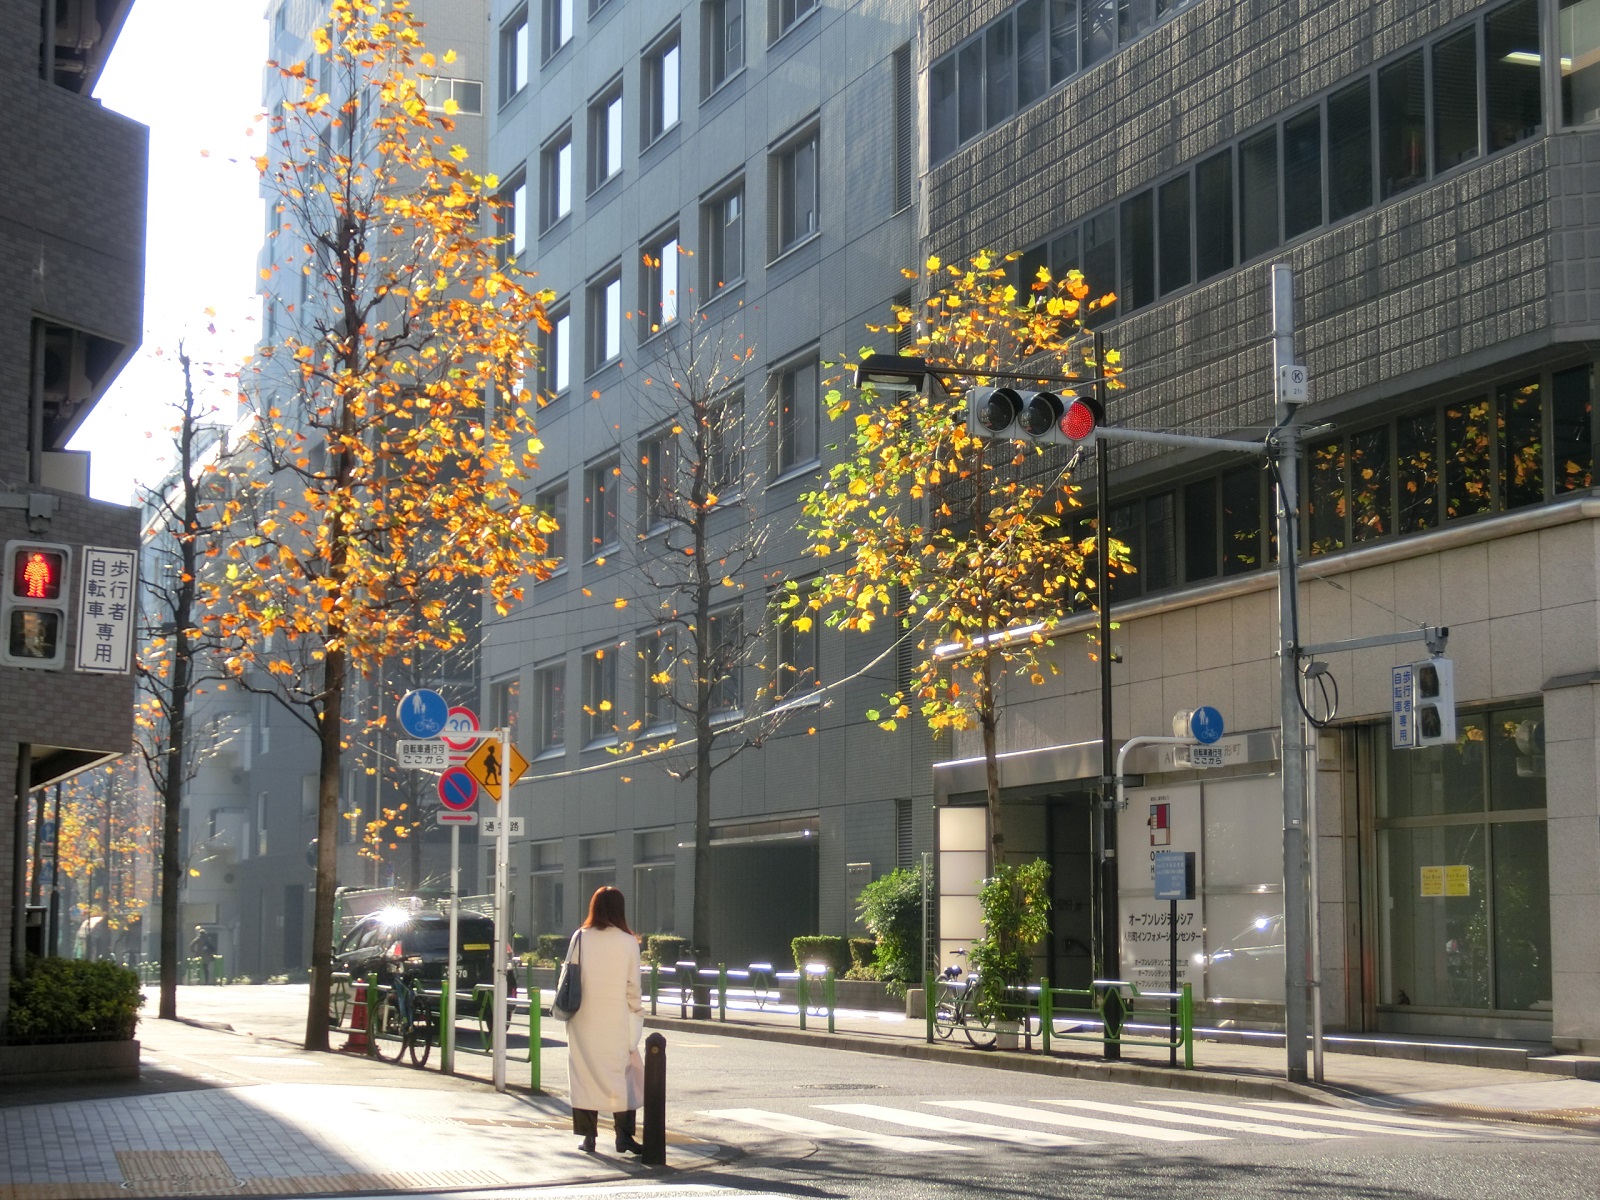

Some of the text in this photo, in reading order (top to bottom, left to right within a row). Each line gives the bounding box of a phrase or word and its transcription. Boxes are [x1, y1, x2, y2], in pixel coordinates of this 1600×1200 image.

[86, 558, 106, 618] 自転車
[108, 560, 130, 620] 歩行者
[94, 623, 115, 663] 専用
[403, 744, 445, 754] 自転車通行可
[403, 755, 444, 764] ここから
[1194, 749, 1222, 757] 自転車通行可
